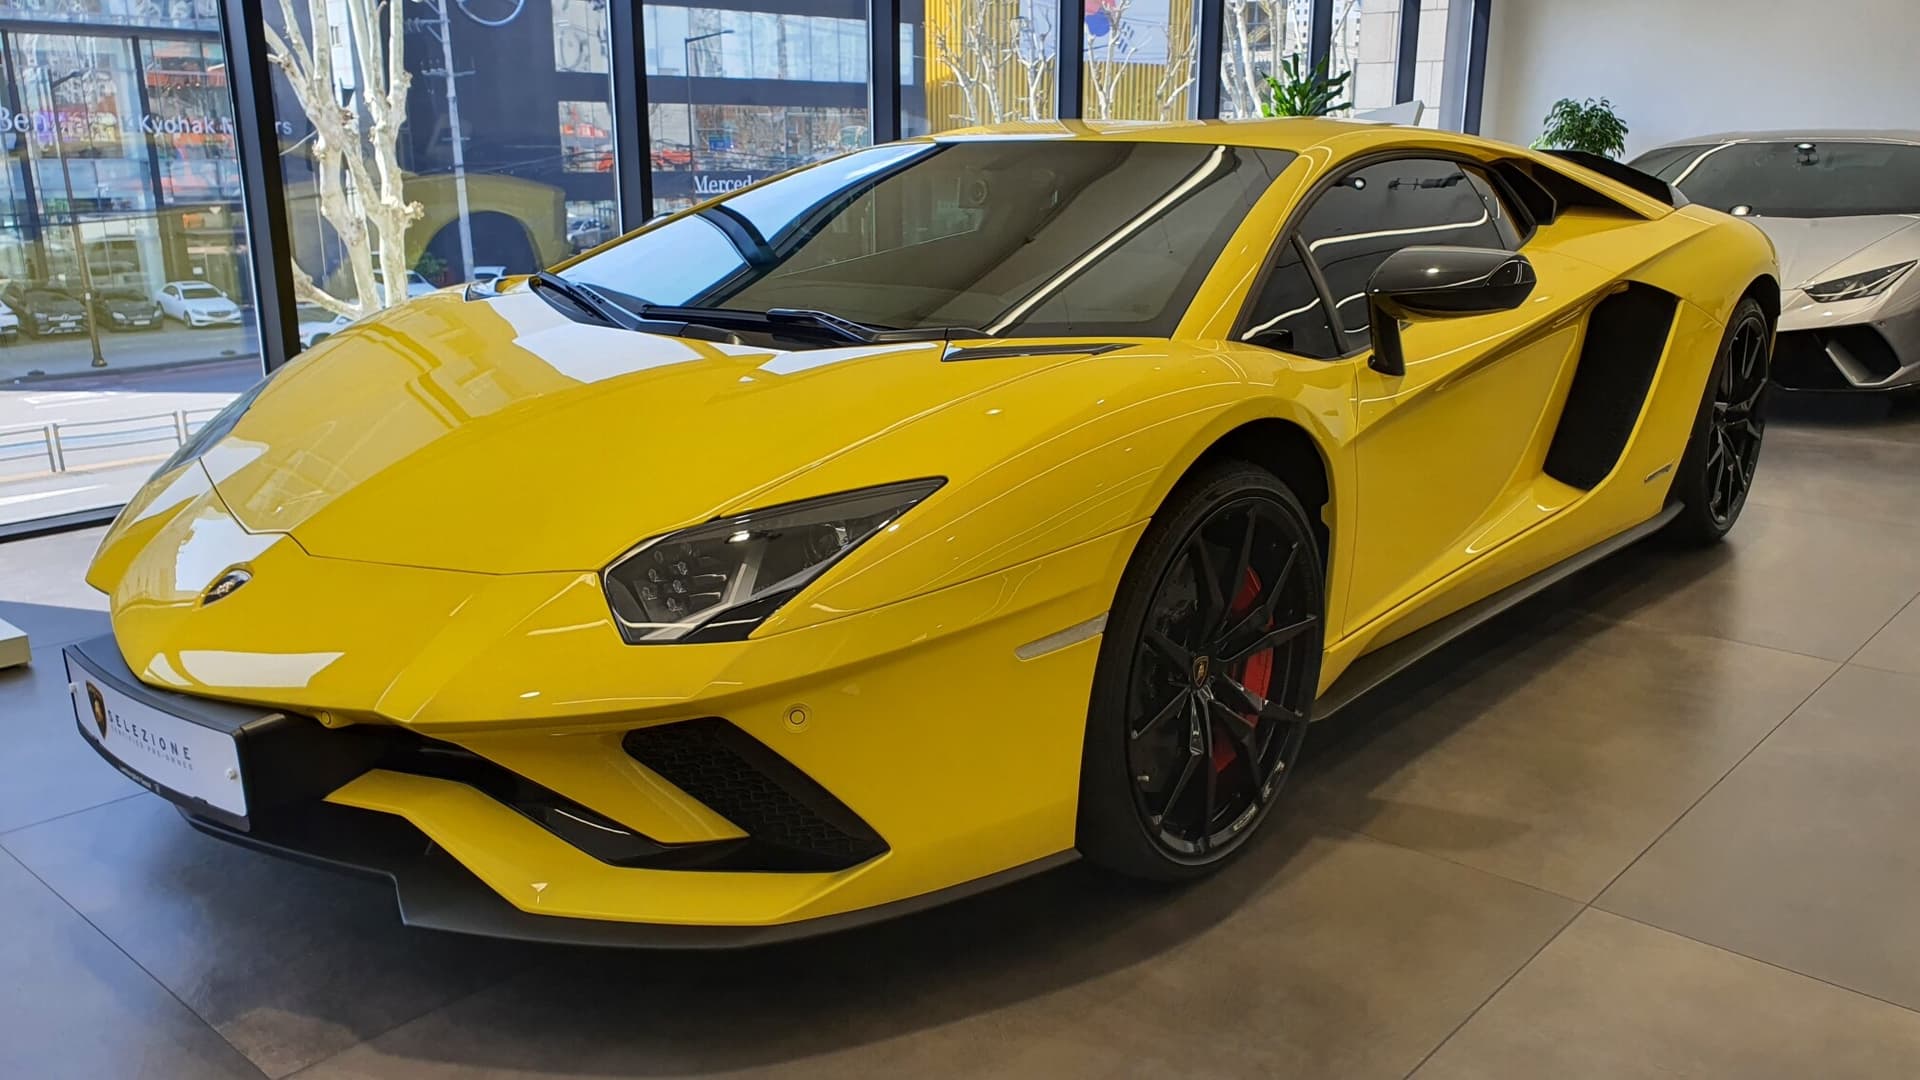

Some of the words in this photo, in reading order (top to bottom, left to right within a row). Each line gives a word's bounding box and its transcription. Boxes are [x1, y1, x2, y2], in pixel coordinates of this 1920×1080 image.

[138, 114, 216, 136] Kyohak
[694, 174, 761, 194] Merced
[107, 710, 191, 761] SELEZIONE
